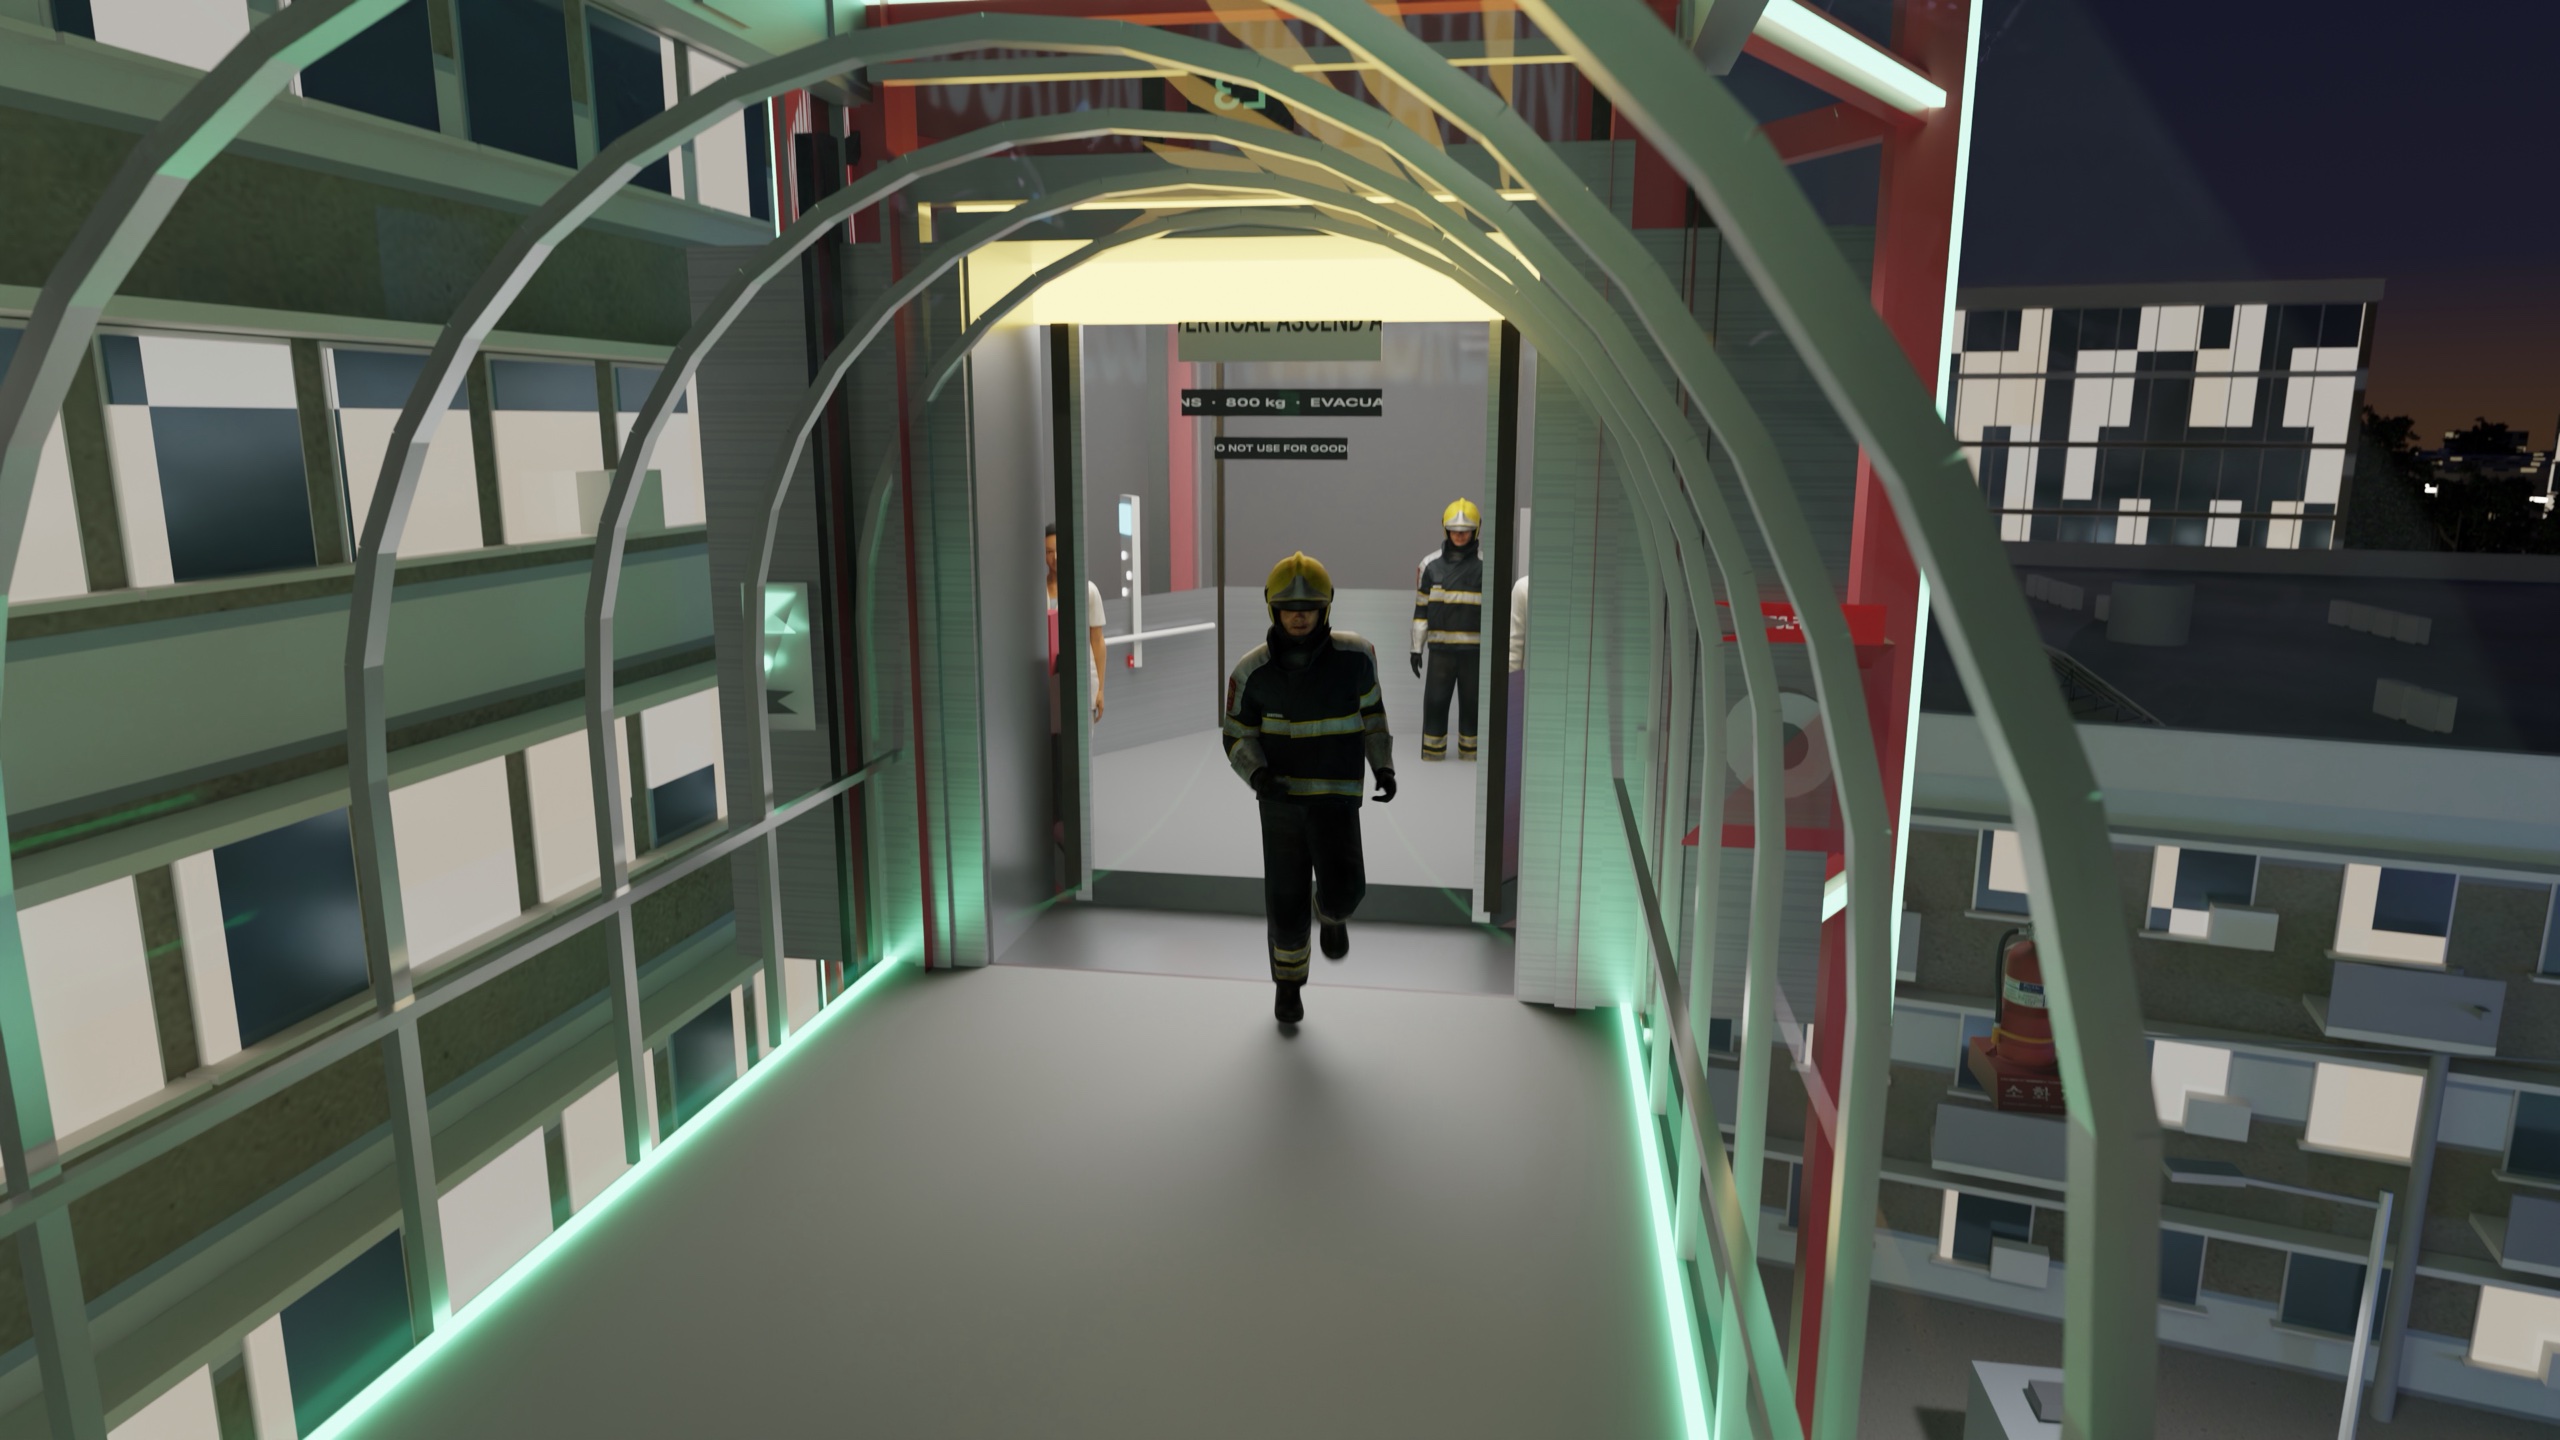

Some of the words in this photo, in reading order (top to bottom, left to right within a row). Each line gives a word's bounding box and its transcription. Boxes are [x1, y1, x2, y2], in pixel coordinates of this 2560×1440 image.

[1178, 321, 1271, 333] ERTICAL
[1226, 397, 1260, 408] 800
[1265, 397, 1286, 410] kg
[1310, 397, 1383, 408] EVACUA
[1228, 443, 1254, 453] NOT
[1256, 443, 1280, 453] USE
[1283, 443, 1307, 453] FOR
